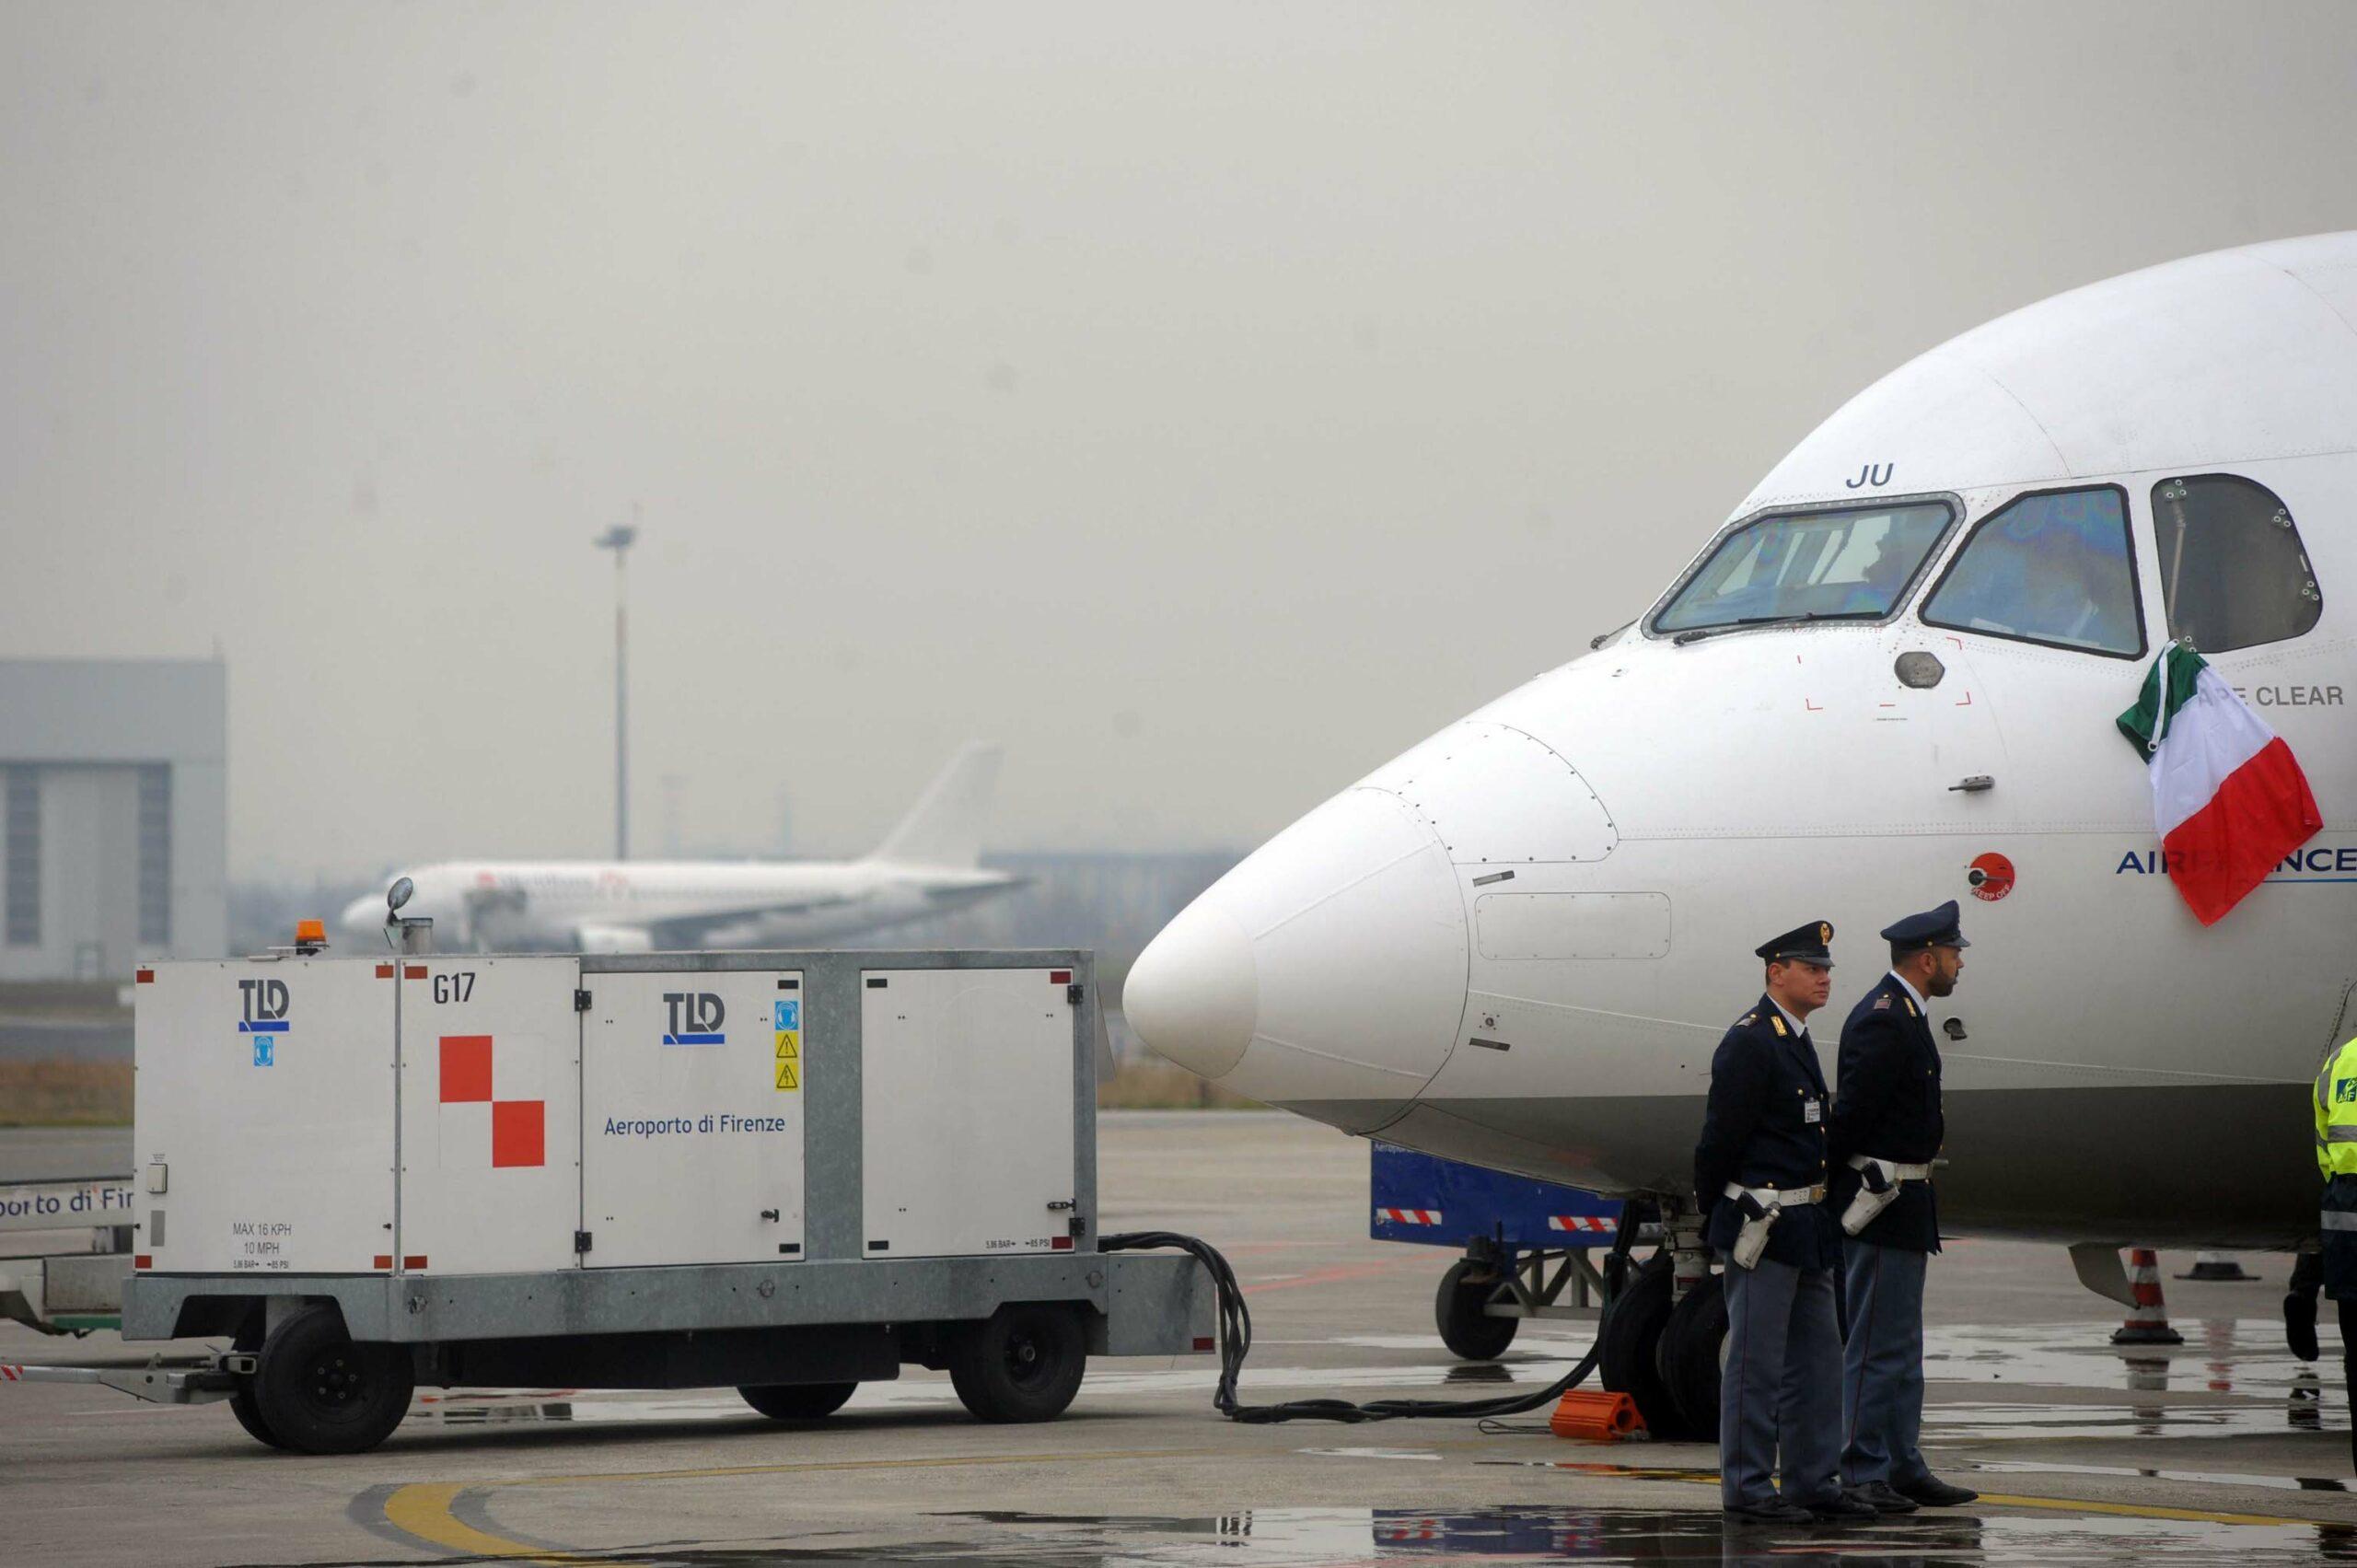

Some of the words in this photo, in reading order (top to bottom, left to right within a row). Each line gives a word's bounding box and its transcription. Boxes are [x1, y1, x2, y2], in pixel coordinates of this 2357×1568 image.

[1845, 462, 1895, 489] JU
[2255, 685, 2345, 706] CLEAR
[238, 979, 290, 1022] TLD
[434, 971, 476, 1005] G17
[663, 993, 726, 1035] TLD
[604, 1116, 692, 1139] Aeroporto
[697, 1115, 714, 1134] di
[719, 1114, 785, 1133] Firenze
[69, 1190, 93, 1213] di
[232, 1222, 255, 1236] MAX
[258, 1222, 269, 1237] 16
[271, 1223, 293, 1236] KPH
[244, 1241, 255, 1255] 10
[257, 1241, 280, 1255] MPH
